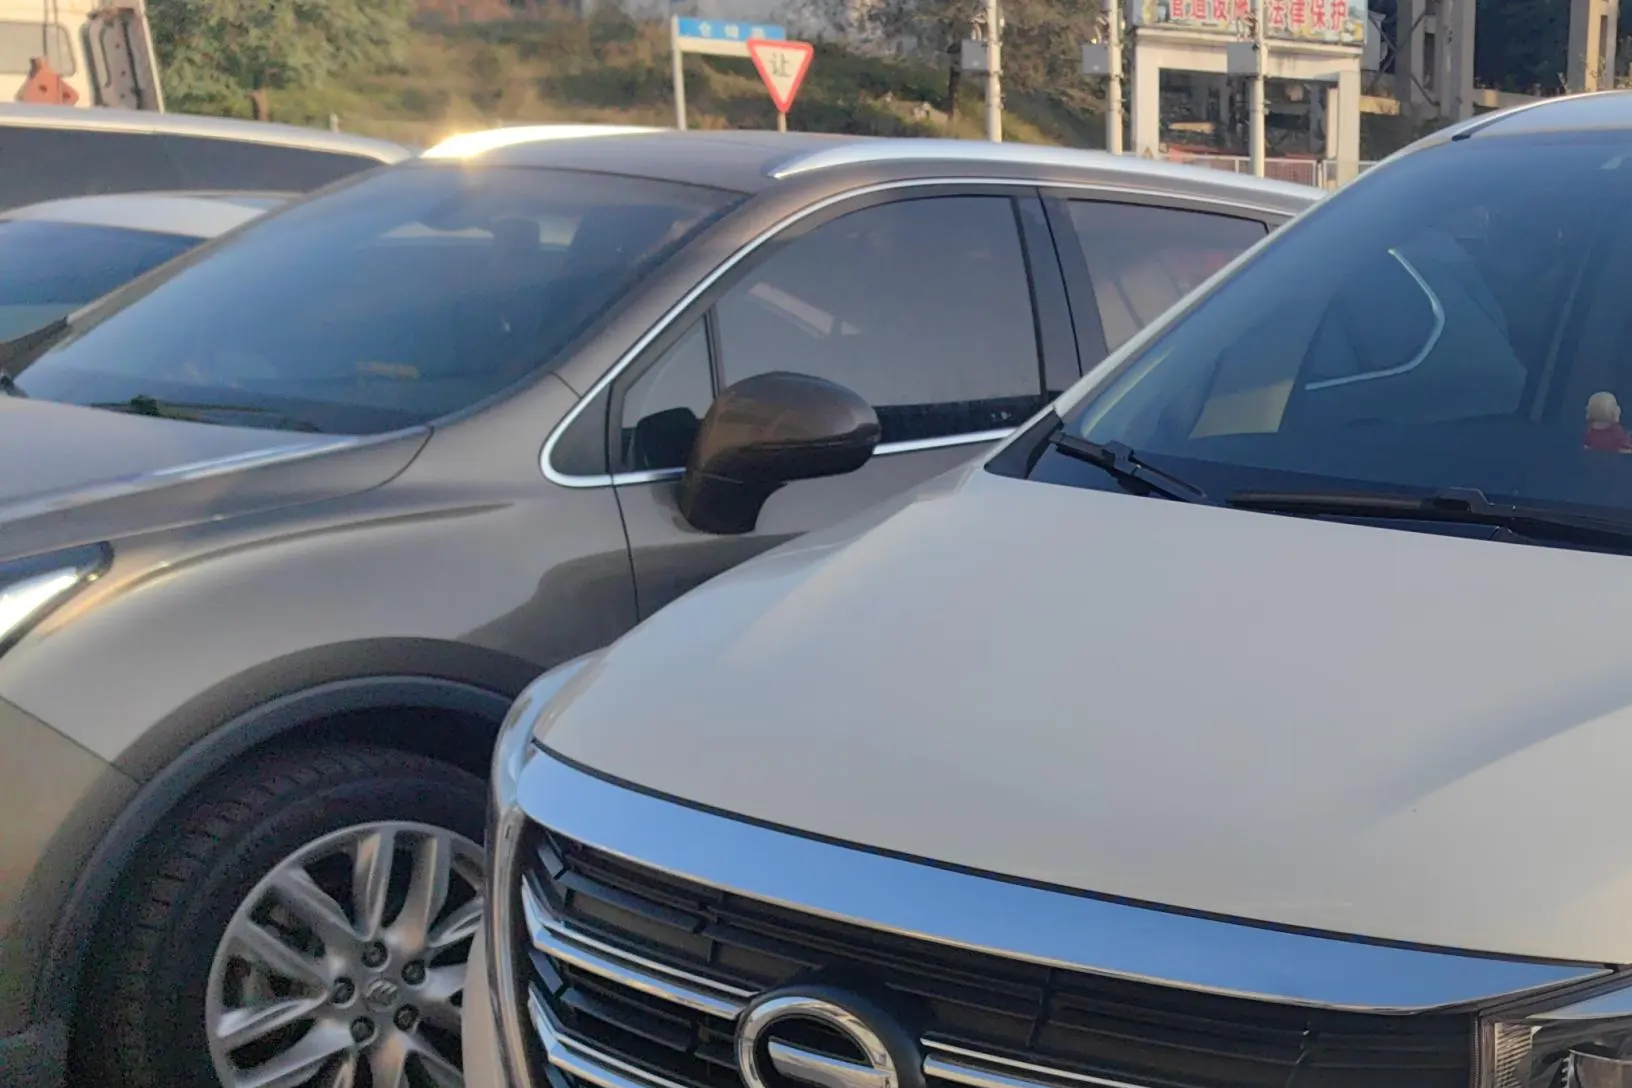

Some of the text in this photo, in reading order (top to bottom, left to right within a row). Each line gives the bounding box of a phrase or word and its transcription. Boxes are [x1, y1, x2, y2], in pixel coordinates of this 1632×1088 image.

[1268, 0, 1346, 30] 法律保护
[768, 51, 792, 78] 让
